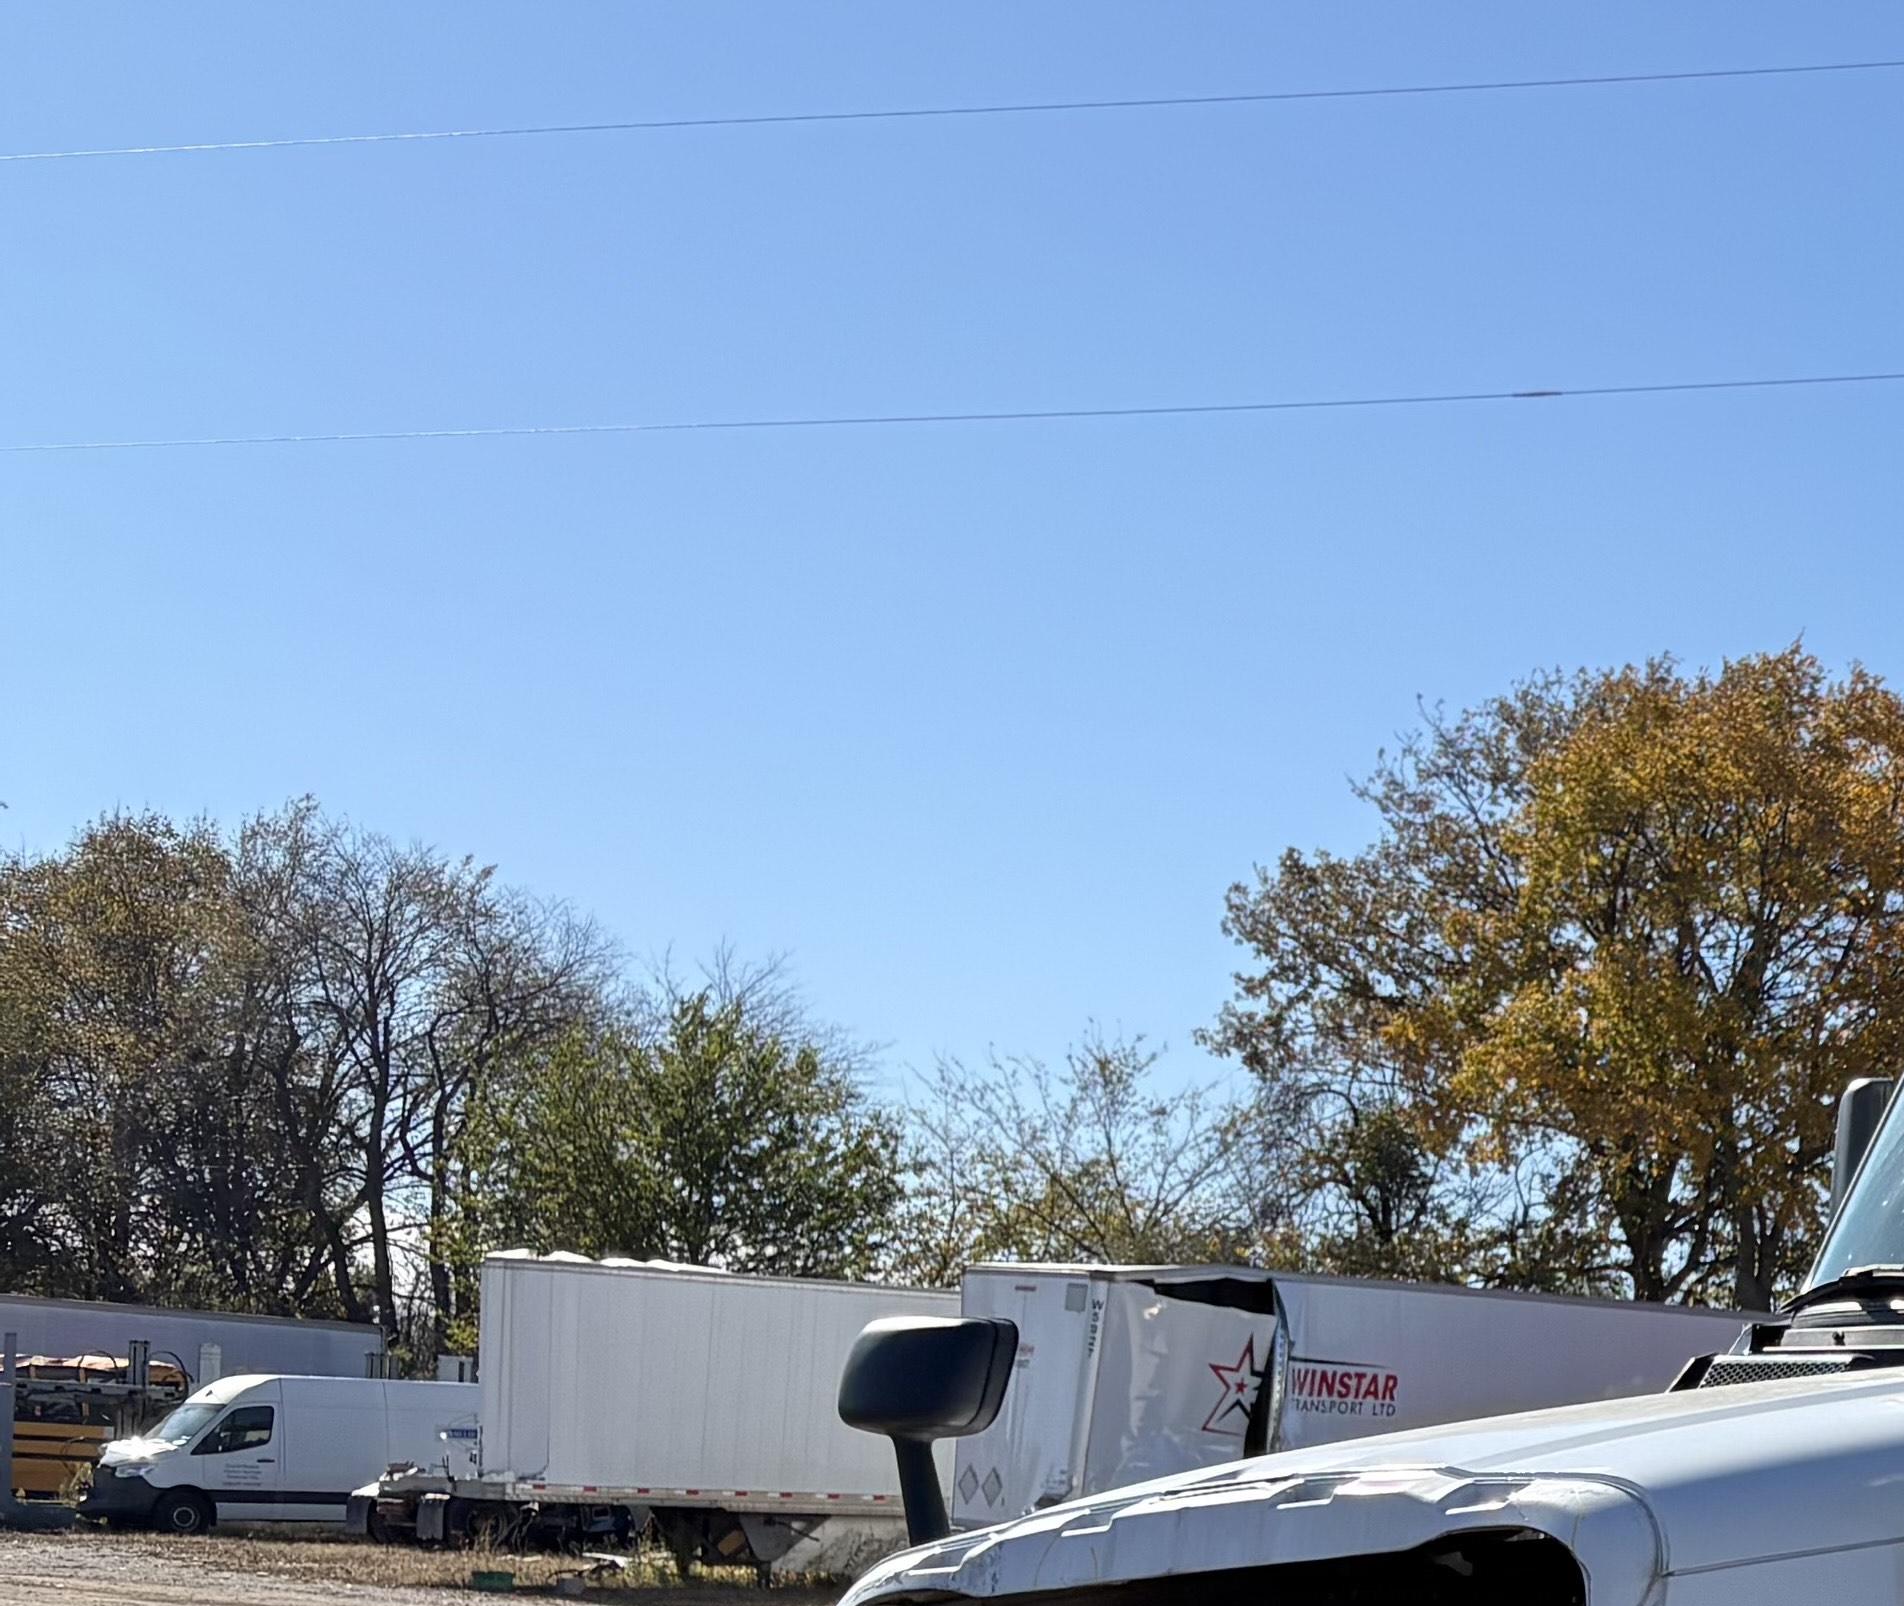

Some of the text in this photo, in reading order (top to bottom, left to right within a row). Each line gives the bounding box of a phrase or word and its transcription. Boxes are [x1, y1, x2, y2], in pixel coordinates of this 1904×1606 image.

[1291, 1368, 1399, 1402] WINSTAR
[1291, 1397, 1396, 1417] ANSPORT LTD
